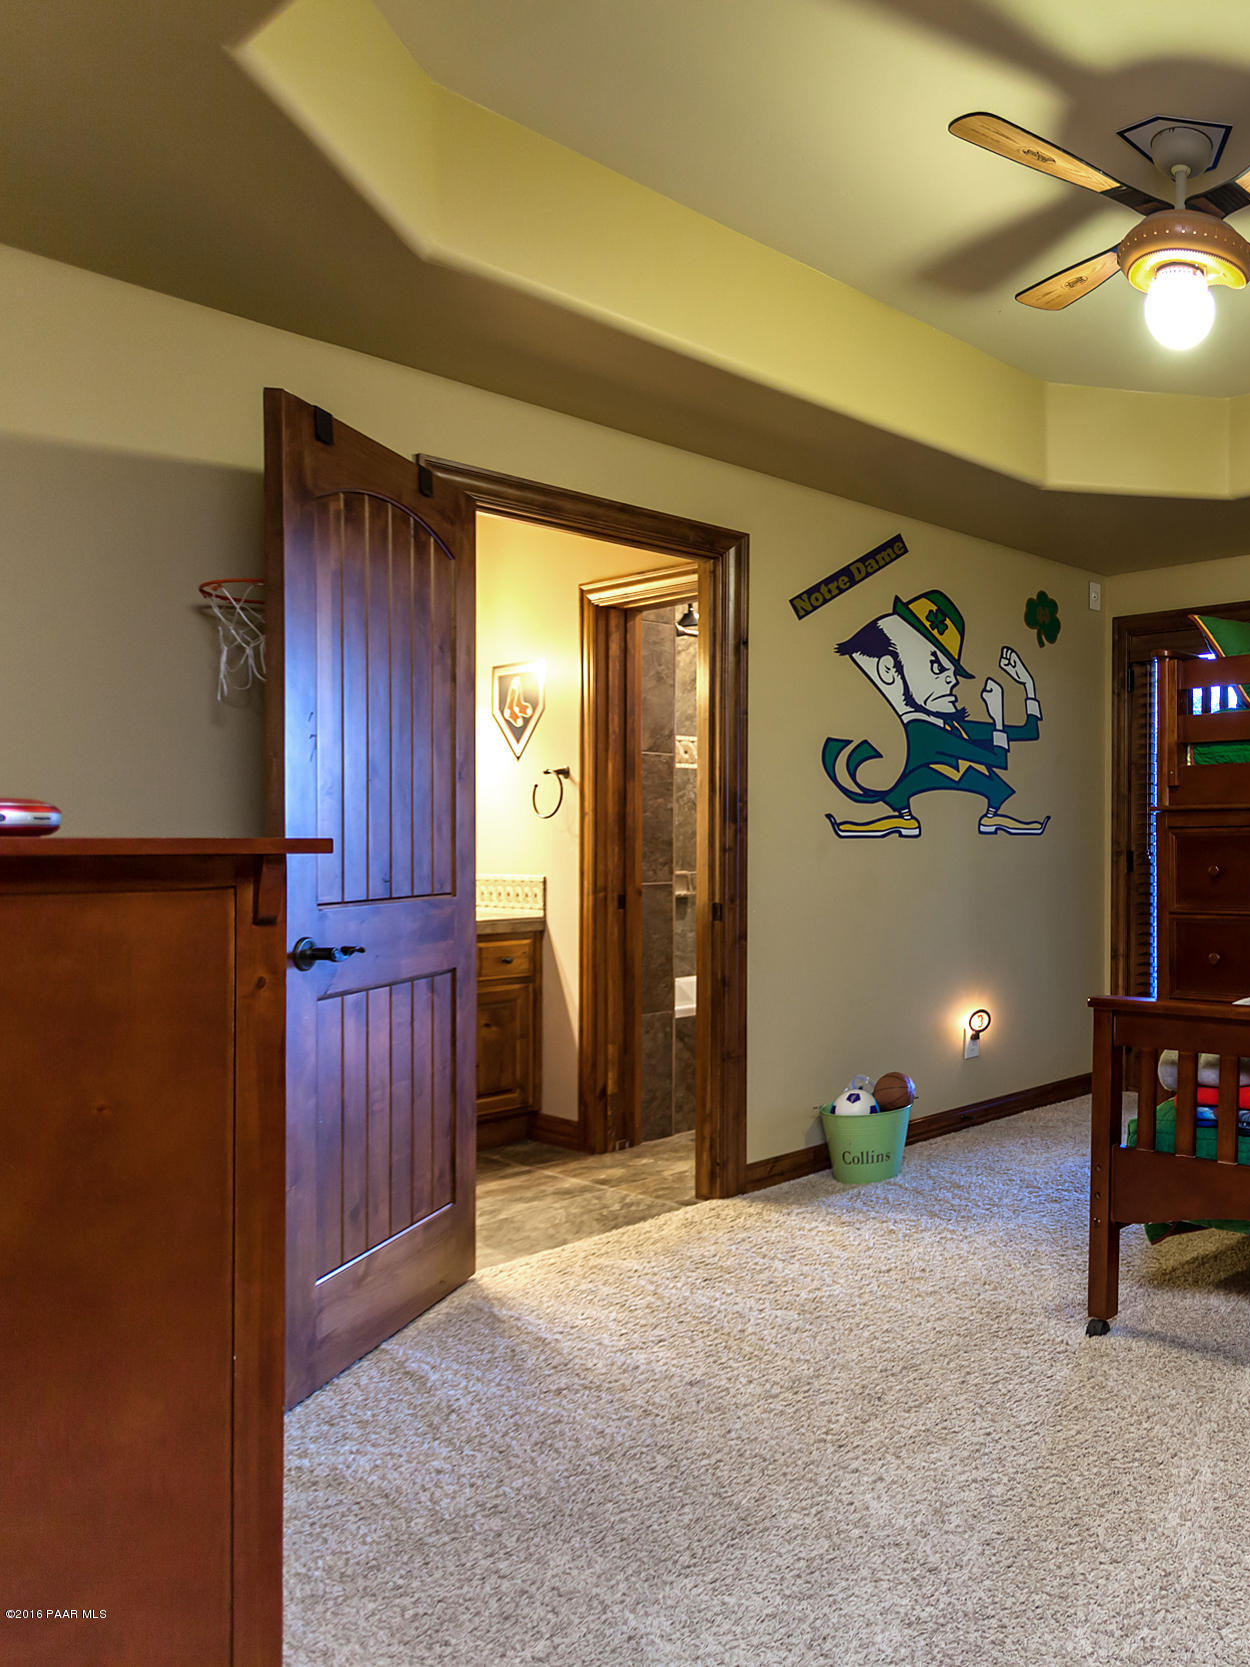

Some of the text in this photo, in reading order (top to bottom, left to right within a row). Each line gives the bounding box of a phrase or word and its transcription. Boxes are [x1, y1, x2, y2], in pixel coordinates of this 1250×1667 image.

[791, 541, 905, 617] Notre Dame
[842, 1150, 892, 1166] Collins
